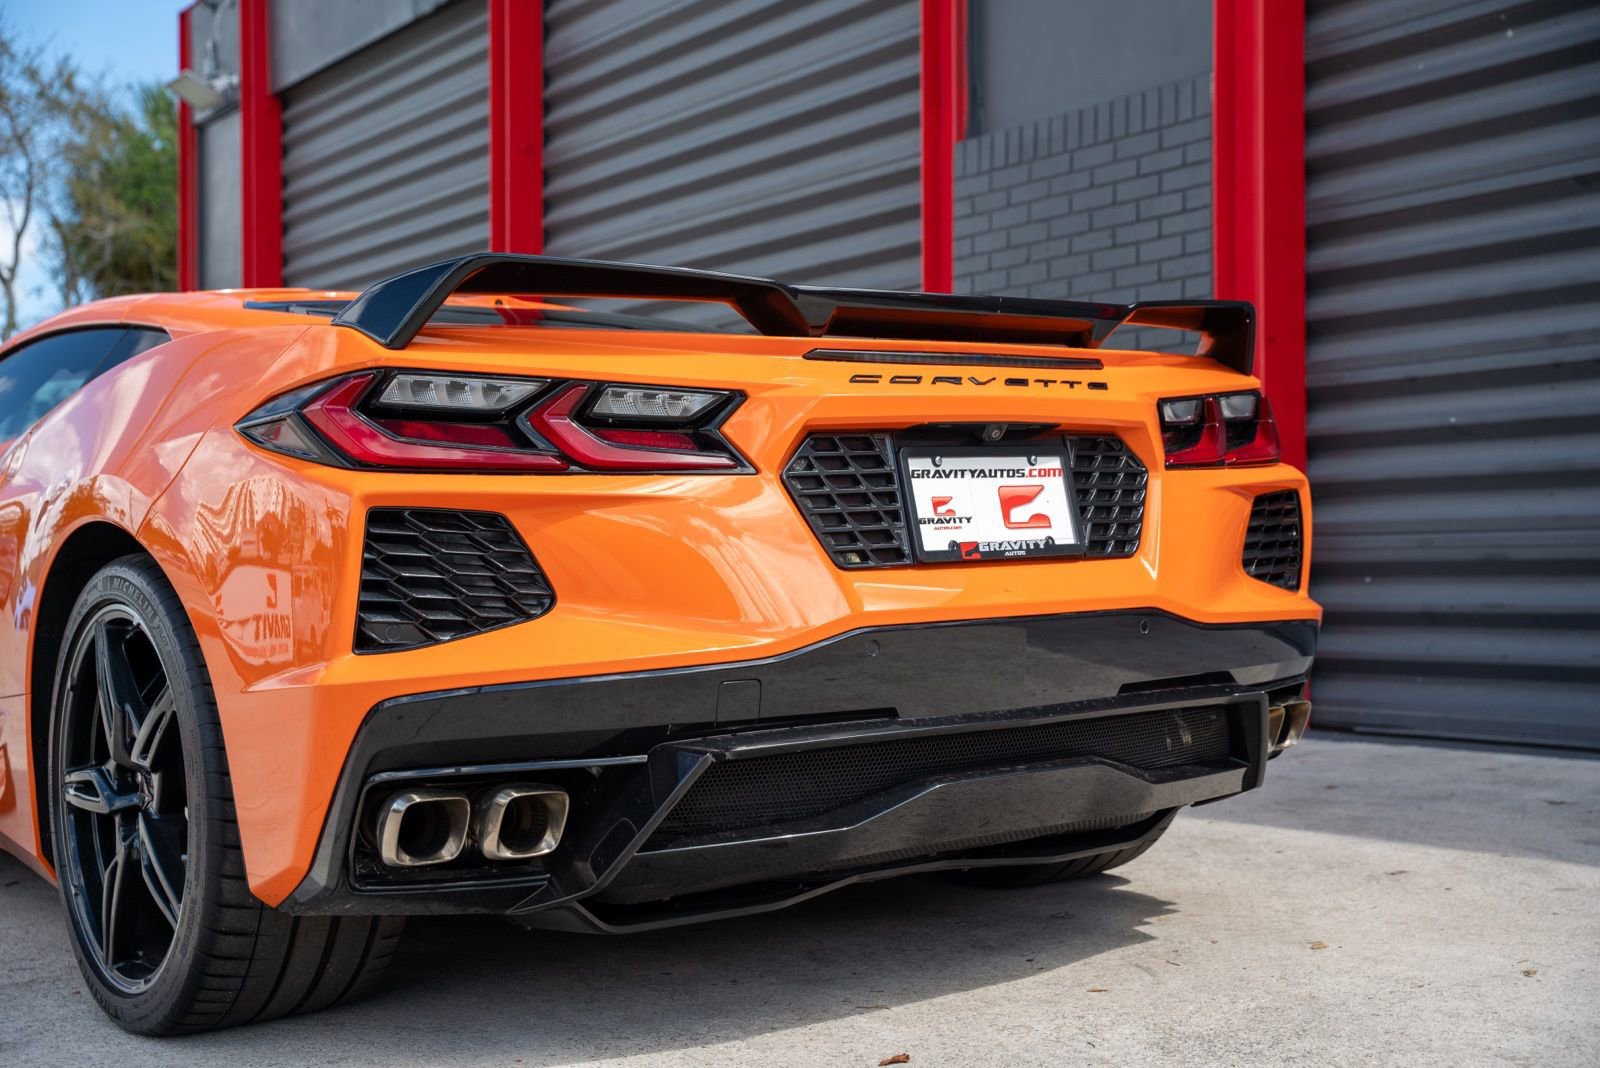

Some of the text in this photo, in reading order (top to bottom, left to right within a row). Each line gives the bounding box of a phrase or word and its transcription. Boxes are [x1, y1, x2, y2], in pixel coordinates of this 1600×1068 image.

[848, 373, 1109, 391] CORVETTE
[910, 467, 1063, 479] GRAVITYAUTOS.COM
[918, 516, 973, 525] GRAVITY
[979, 540, 1046, 551] GRAVITY
[111, 576, 155, 620] MICHELIN
